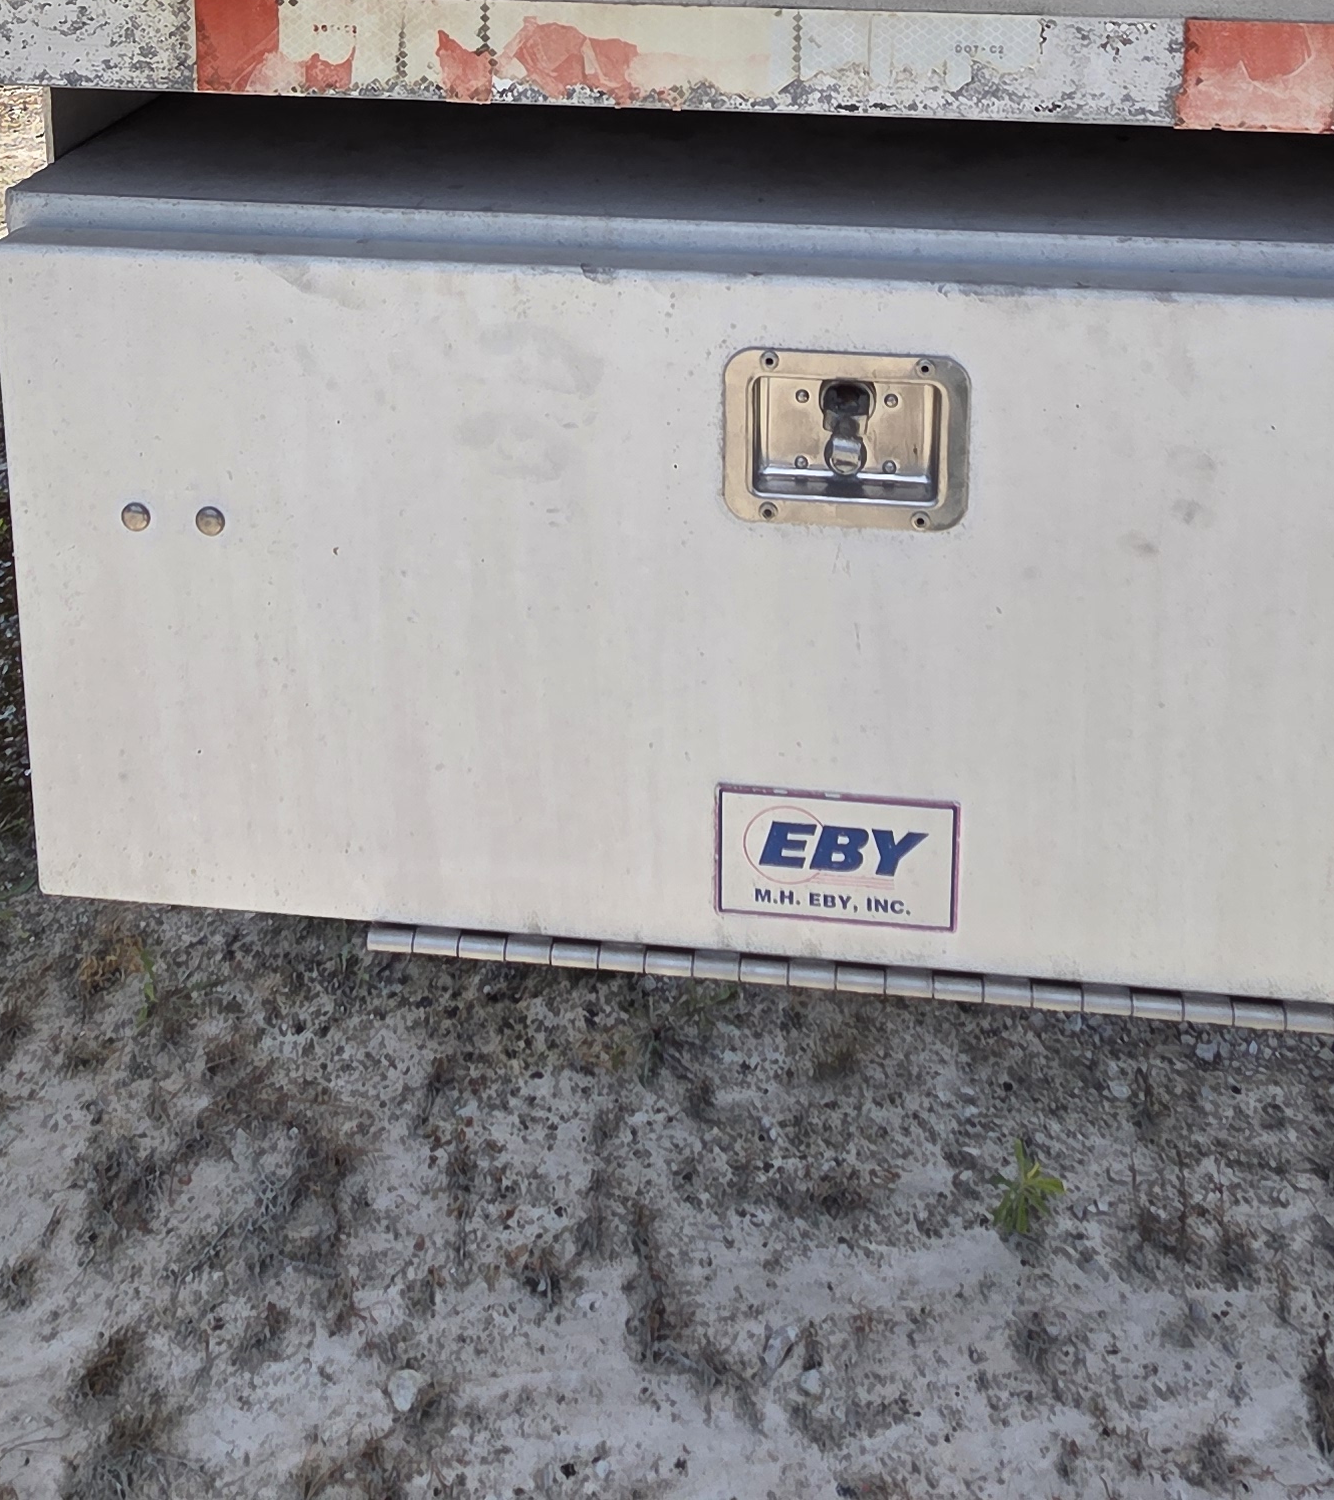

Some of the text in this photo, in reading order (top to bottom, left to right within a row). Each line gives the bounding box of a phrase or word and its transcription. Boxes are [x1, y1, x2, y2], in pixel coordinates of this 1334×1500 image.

[759, 820, 929, 877] EBY
[755, 888, 912, 916] M.H. EBY, INC.
